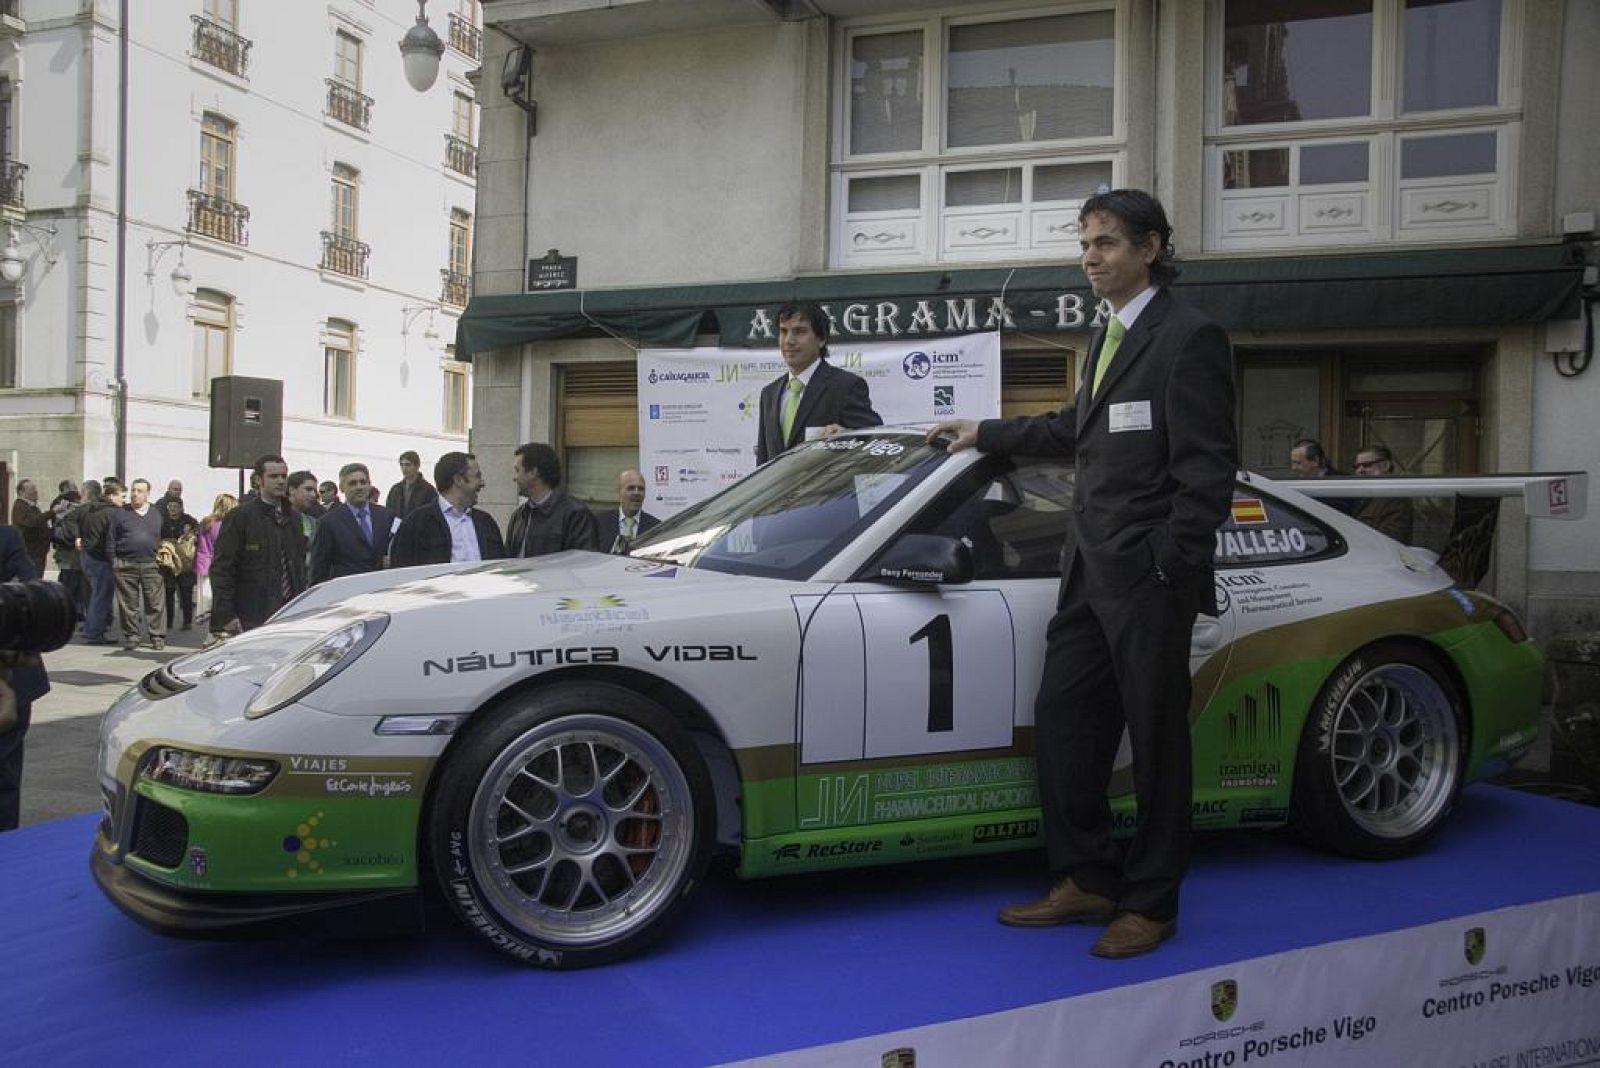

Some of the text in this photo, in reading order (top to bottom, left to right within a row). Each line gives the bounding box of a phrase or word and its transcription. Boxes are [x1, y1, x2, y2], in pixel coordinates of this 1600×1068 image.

[643, 645, 759, 662] VIDAL
[909, 614, 953, 732] 1
[290, 756, 348, 771] VIAJES
[808, 840, 883, 858] RecStore
[453, 882, 537, 960] MICHELIN
[1422, 990, 1486, 1018] Centro
[1490, 973, 1561, 1002] Porsche
[1243, 1026, 1327, 1062] Porsche
[1333, 1015, 1377, 1040] Vigo
